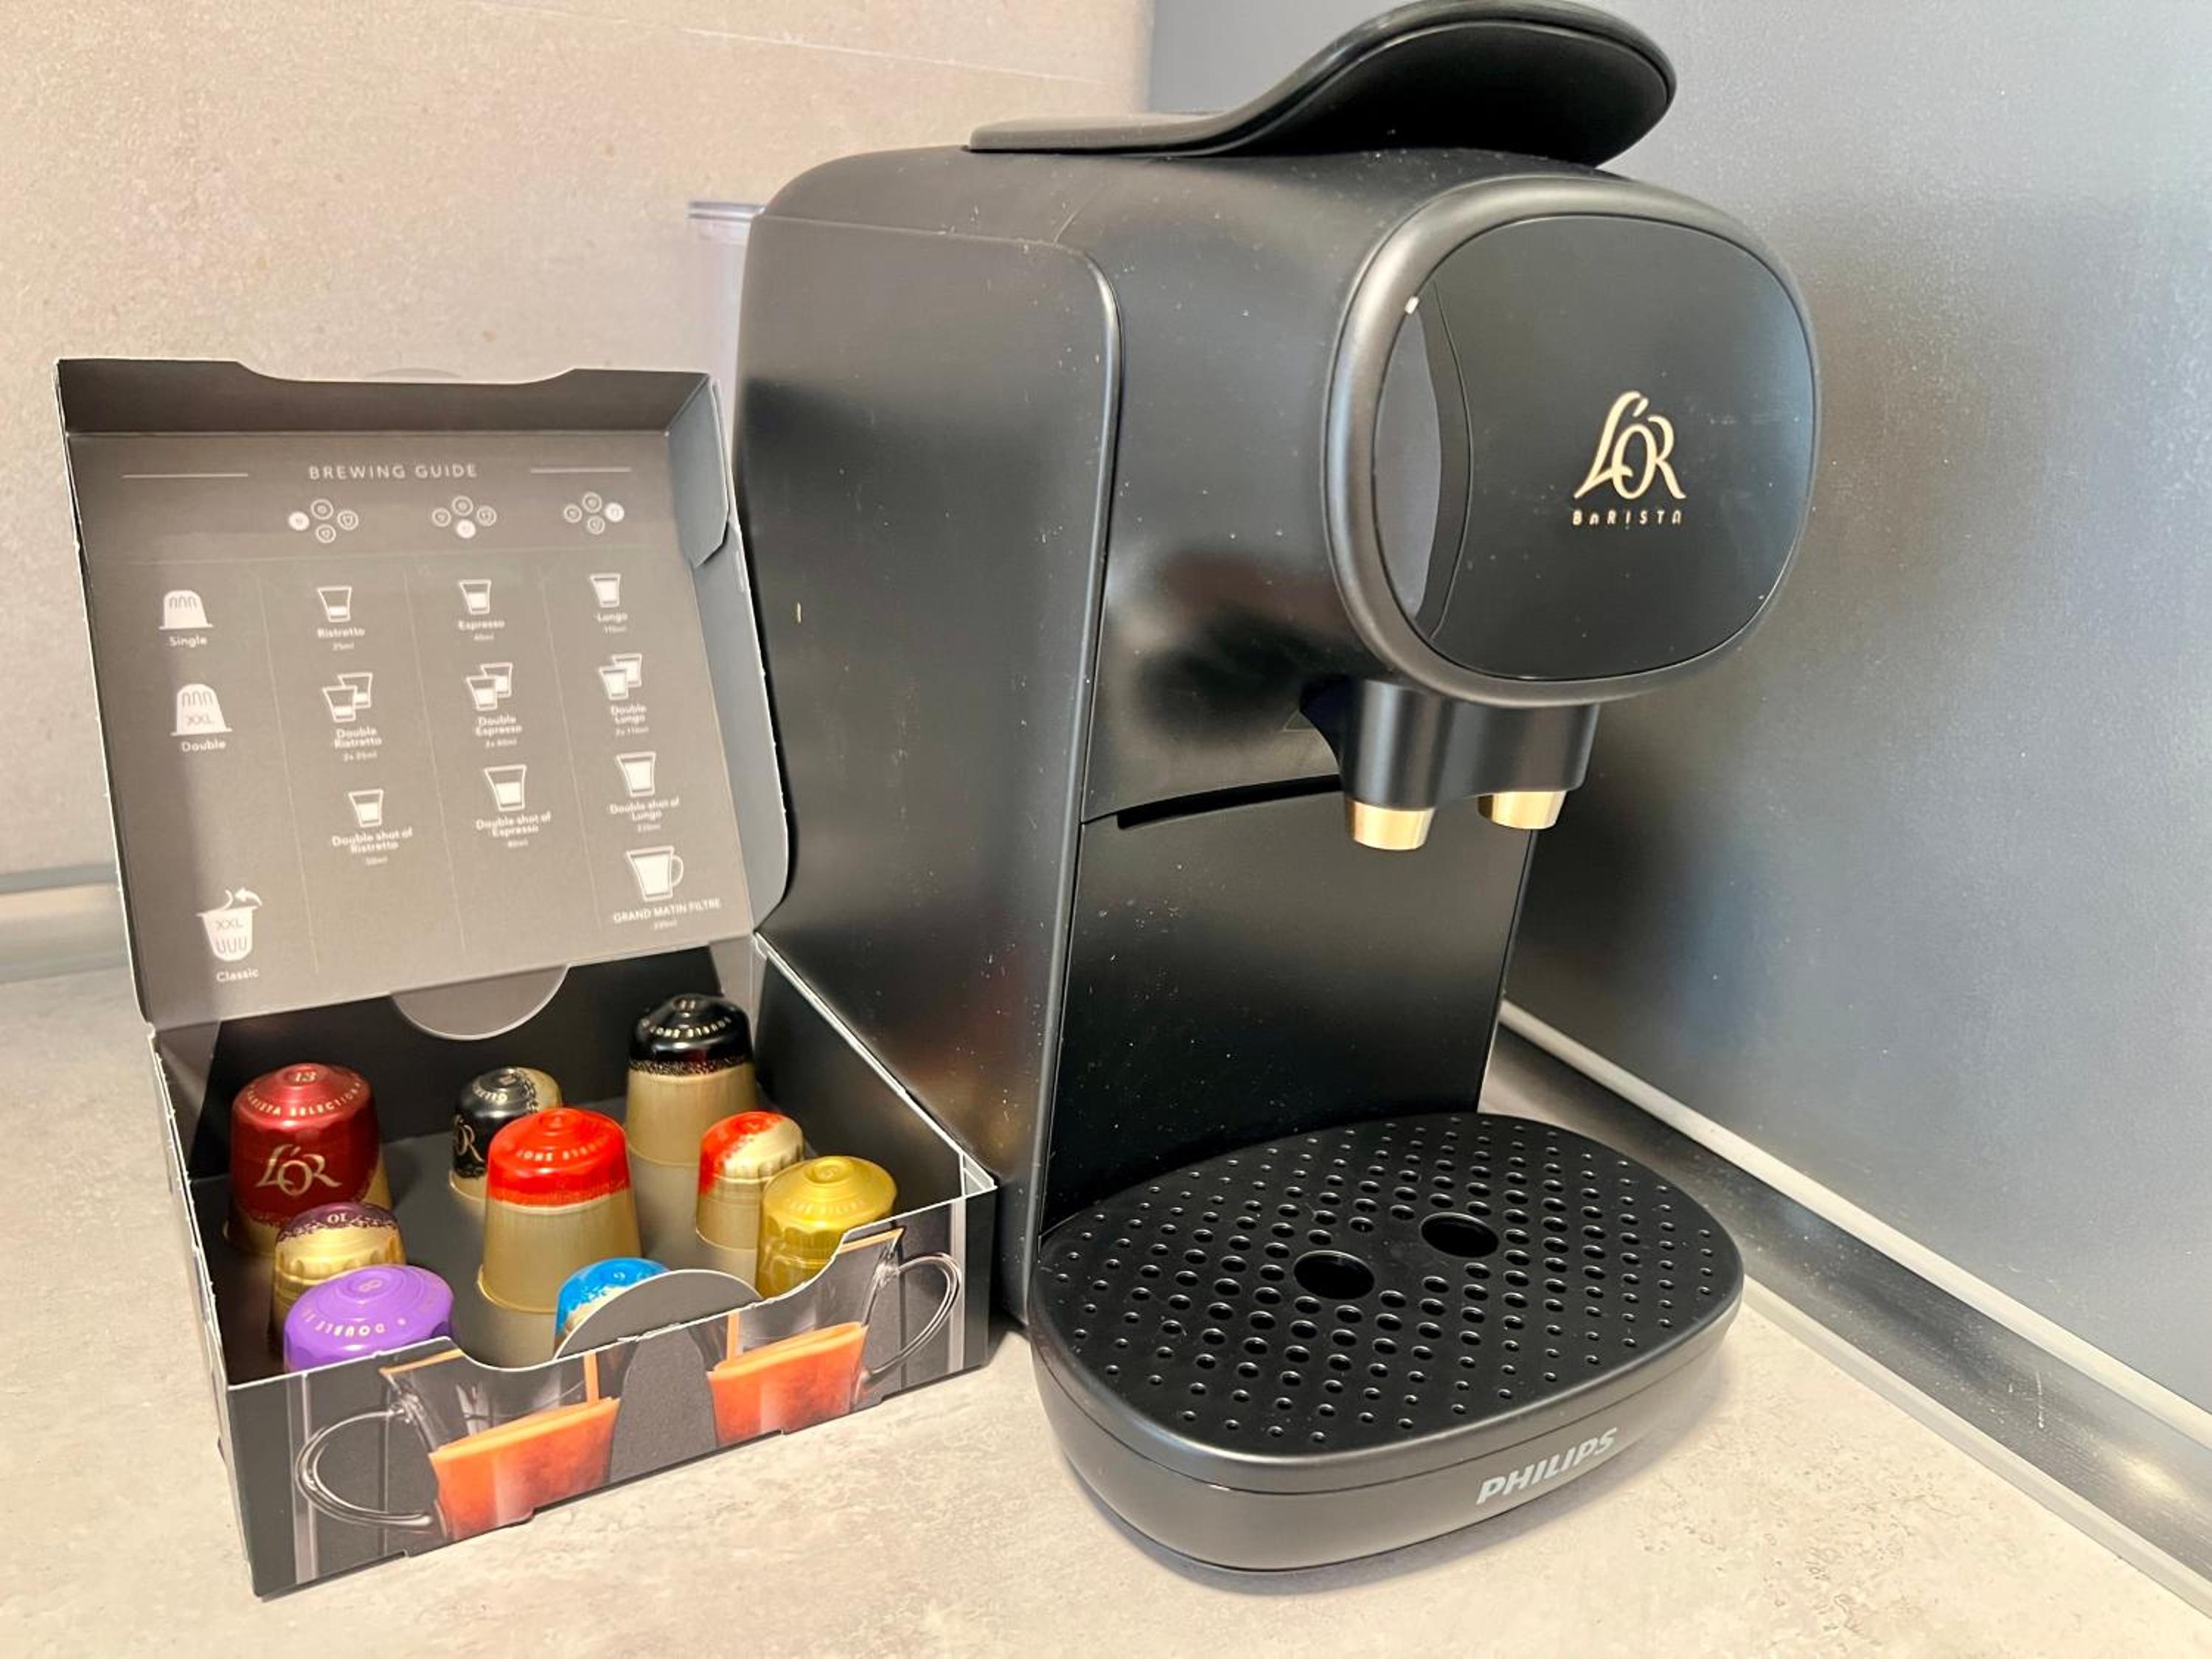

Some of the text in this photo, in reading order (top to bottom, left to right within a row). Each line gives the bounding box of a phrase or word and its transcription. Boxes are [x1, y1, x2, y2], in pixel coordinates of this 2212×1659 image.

[1573, 390, 1687, 499] L'OR
[308, 463, 478, 480] BREWING GUIDE
[597, 613, 627, 623] Lungo
[458, 620, 505, 630] Espresso
[317, 627, 366, 638] Ristretto
[169, 635, 207, 648] Single
[611, 704, 647, 716] Double
[187, 714, 215, 725] XXL
[479, 715, 517, 726] Double
[336, 726, 378, 738] Double
[476, 725, 522, 737] Espresso
[181, 740, 226, 752] Double
[334, 737, 383, 748] Ristretto
[610, 796, 681, 815] Double shot of
[476, 811, 552, 830] Double shot of
[631, 810, 663, 823] Lungo
[331, 827, 414, 847] Double shot of
[492, 825, 539, 838] Espresso
[350, 839, 400, 854] Ristretto
[613, 898, 722, 924] GRAND MATIN FILTRE
[215, 919, 244, 929] XXL
[216, 967, 260, 982] Classic
[255, 1144, 343, 1197] L'OR
[1475, 1427, 1618, 1506] PHILIPS
